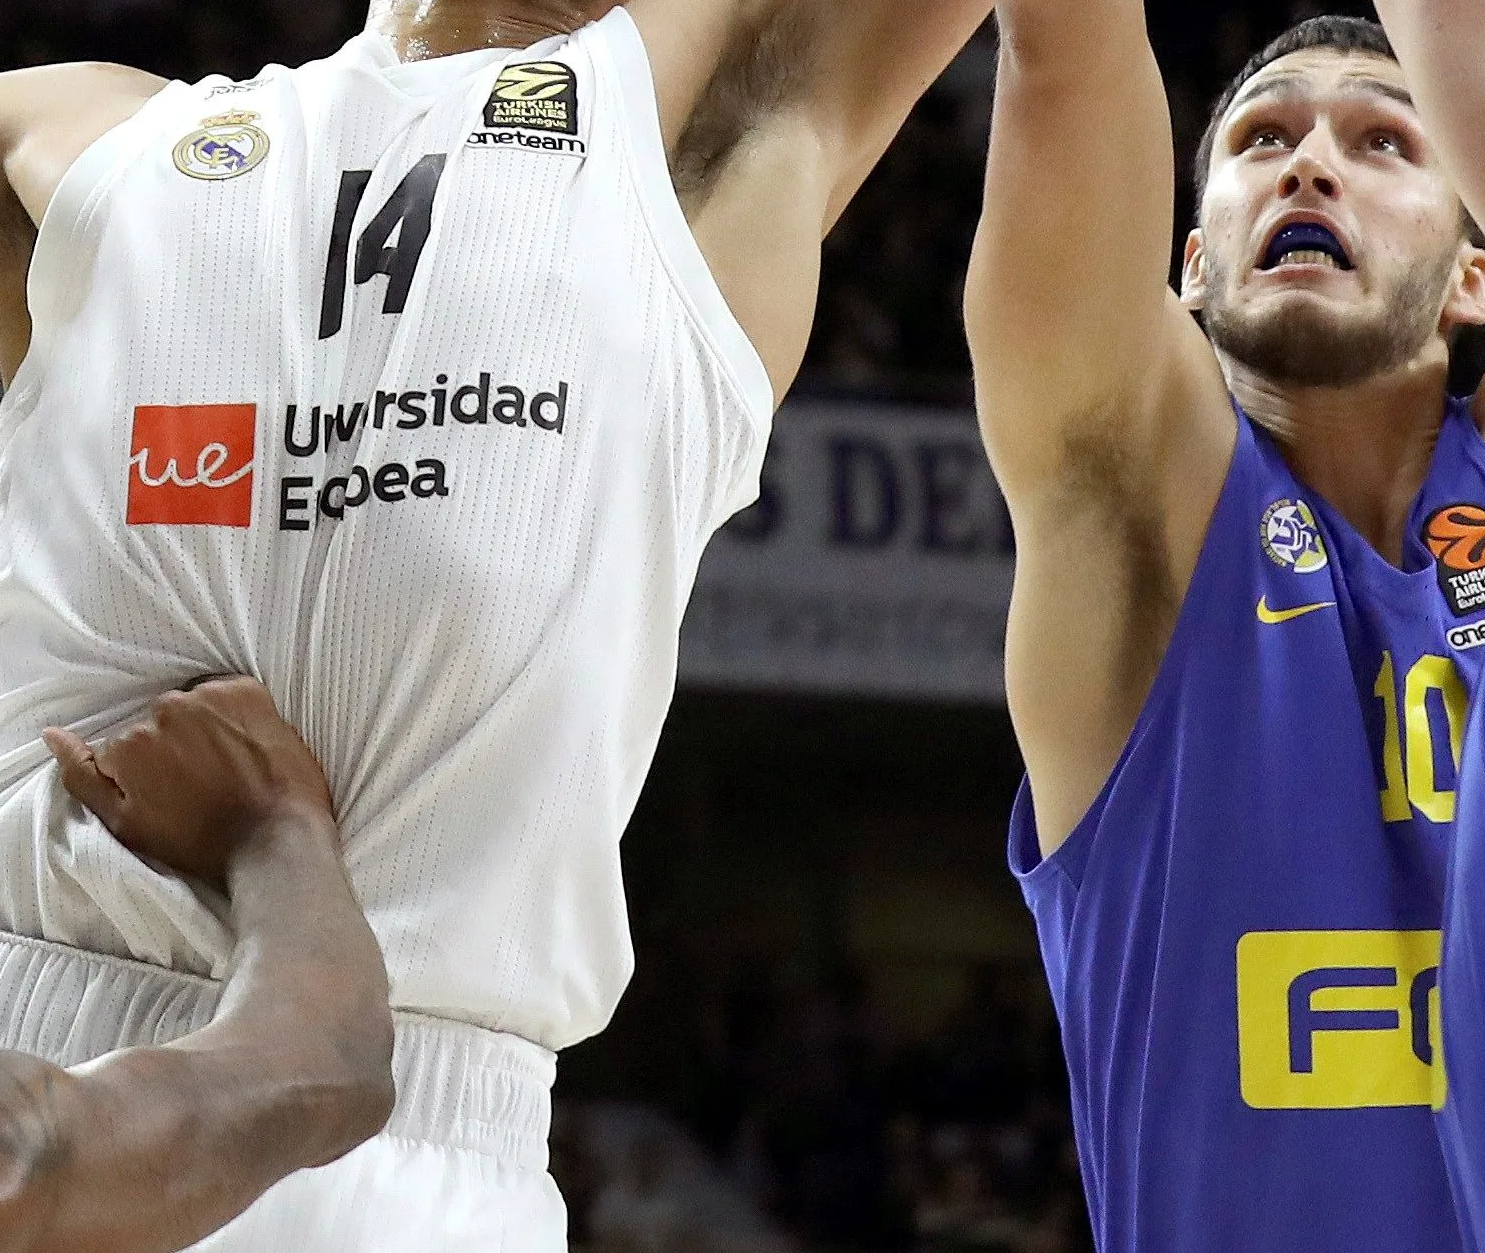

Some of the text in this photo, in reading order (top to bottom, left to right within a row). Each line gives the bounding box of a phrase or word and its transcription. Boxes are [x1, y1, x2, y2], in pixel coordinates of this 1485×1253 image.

[492, 100, 566, 110] TURKISH
[494, 108, 567, 119] AIRLINES
[319, 153, 447, 340] 14
[1373, 650, 1473, 823] 10
